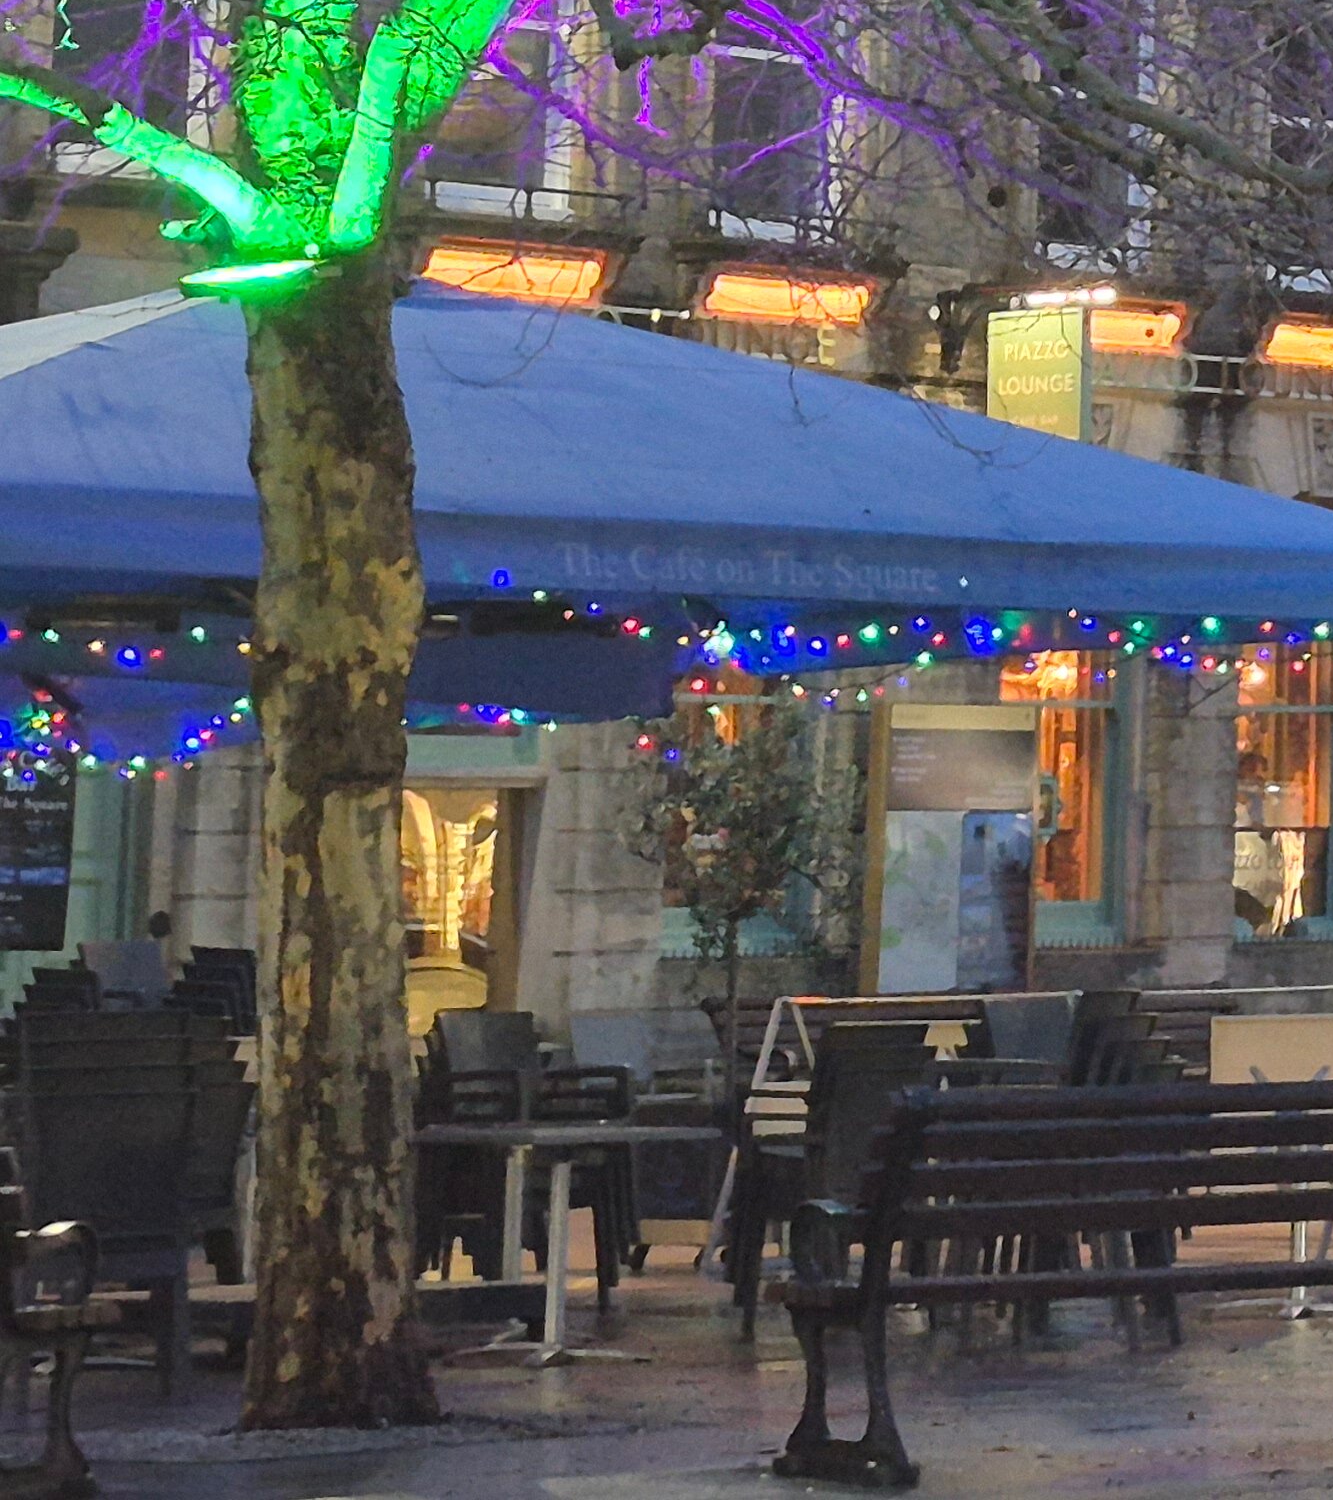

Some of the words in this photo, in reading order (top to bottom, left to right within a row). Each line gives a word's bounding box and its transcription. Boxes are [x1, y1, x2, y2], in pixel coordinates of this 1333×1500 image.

[1003, 340, 1071, 362] PIAZZO
[998, 373, 1075, 396] LOUNGE
[563, 543, 617, 578] The
[716, 555, 756, 584] on
[763, 550, 824, 587] The
[832, 553, 941, 599] Square
